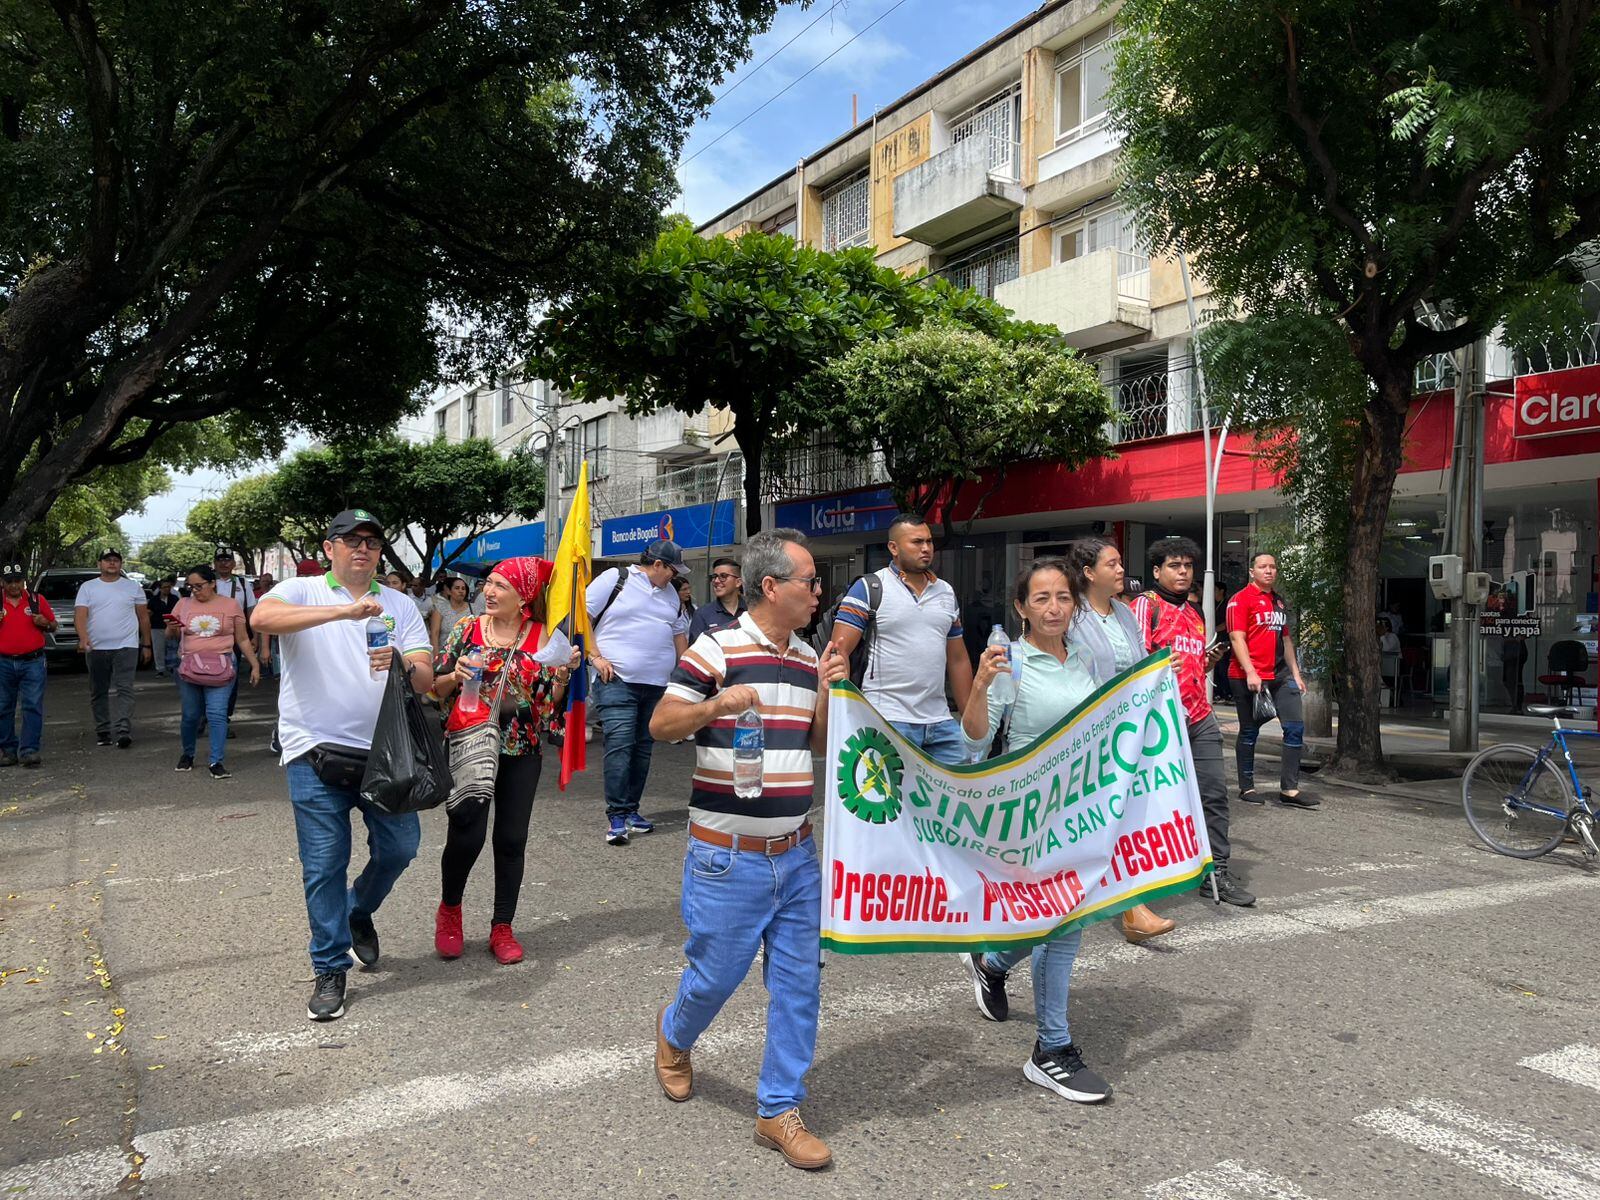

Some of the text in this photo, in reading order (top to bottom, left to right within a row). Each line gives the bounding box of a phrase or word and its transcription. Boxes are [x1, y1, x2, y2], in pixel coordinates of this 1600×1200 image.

[1521, 392, 1600, 426] Clar
[612, 525, 659, 543] Banco de Bogotá
[1480, 624, 1540, 637] amá y papá
[1511, 617, 1540, 625] conectar
[1175, 635, 1203, 656] CCCP
[916, 763, 982, 799] Sindicato
[987, 785, 1005, 798] de
[1010, 748, 1070, 793] Trabajadores
[1071, 738, 1081, 753] de
[1082, 730, 1091, 745] la
[1117, 701, 1130, 716] de
[1131, 677, 1174, 708] Colobi
[913, 759, 1188, 867] SUBDIRECTIVA SAN CETAN
[831, 859, 968, 923] Presente...
[1100, 810, 1199, 888] resente
